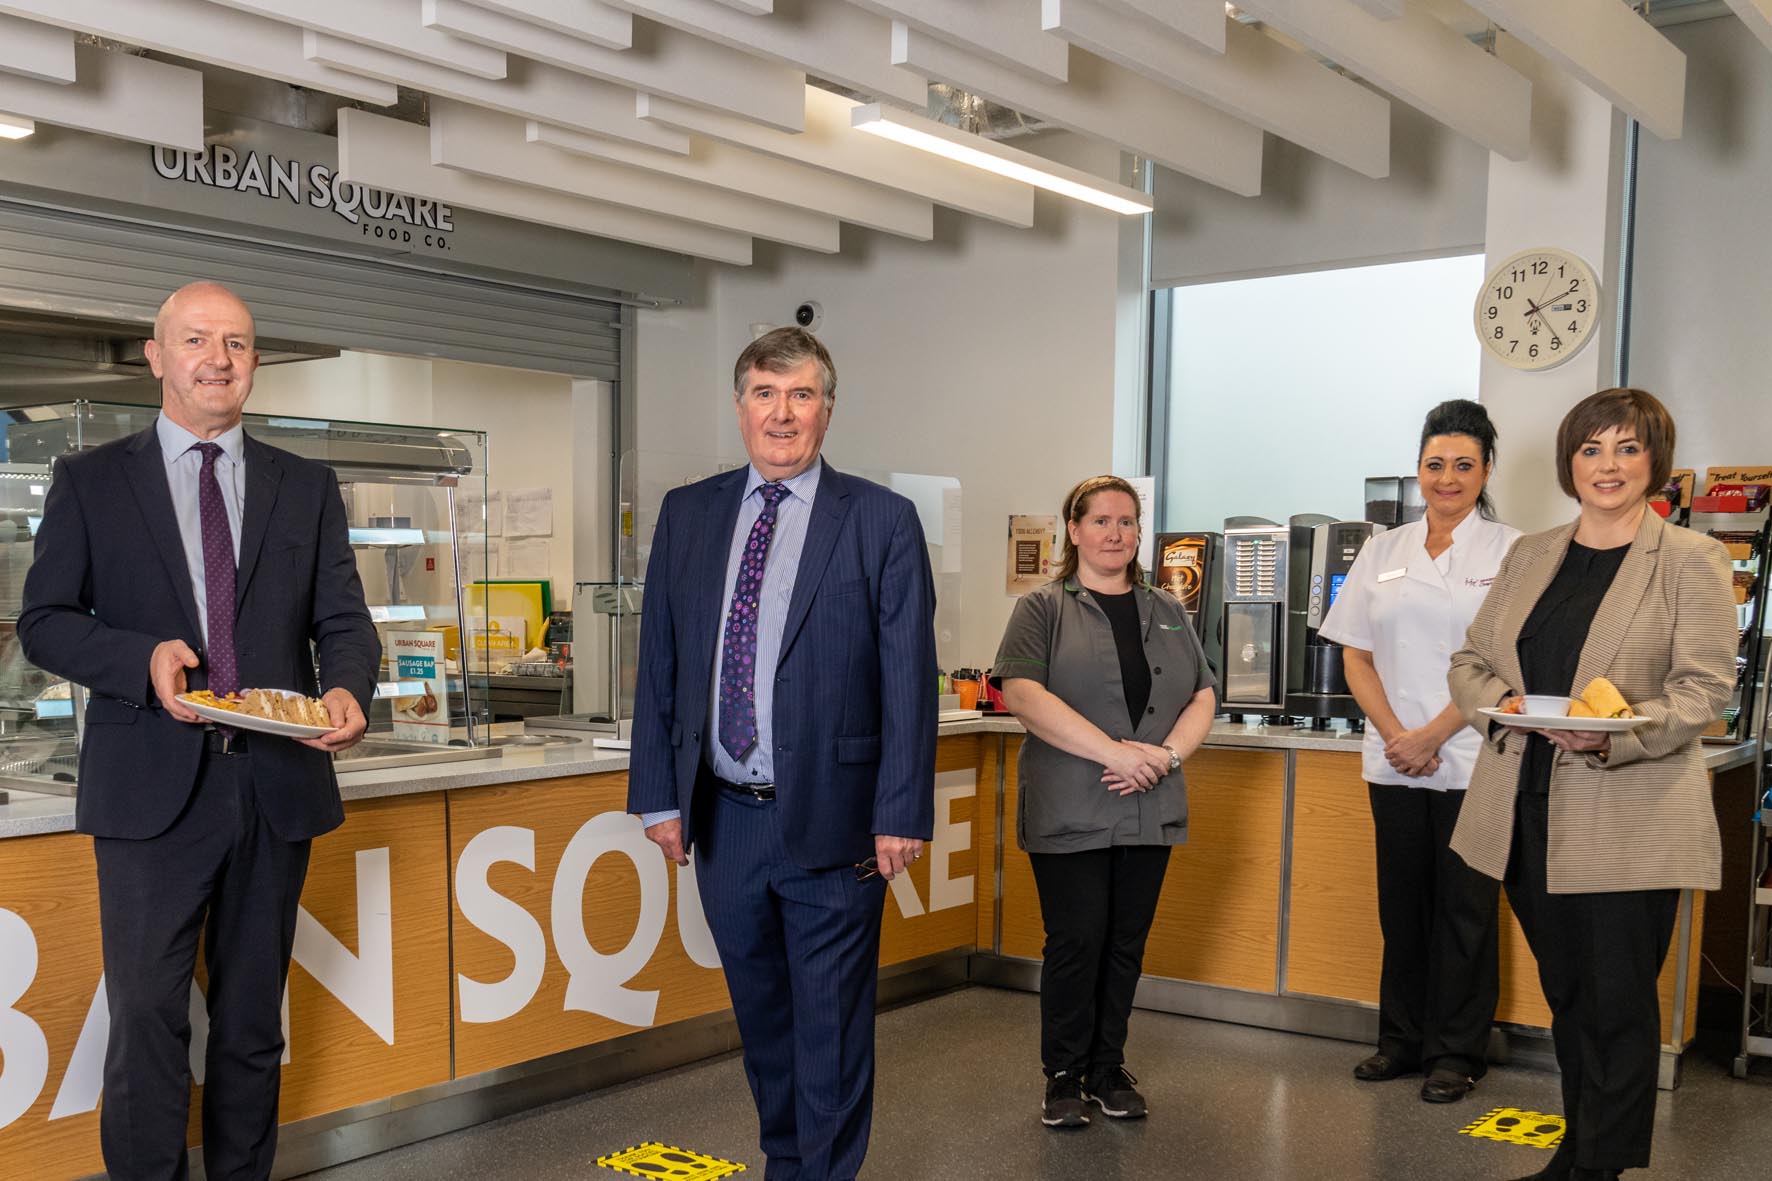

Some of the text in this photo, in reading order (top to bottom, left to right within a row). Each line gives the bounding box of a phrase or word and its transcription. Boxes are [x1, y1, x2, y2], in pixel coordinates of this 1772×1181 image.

[151, 144, 454, 232] URBAN SQUARE
[362, 223, 451, 251] FOOD CO.
[1531, 261, 1549, 275] 12
[1558, 265, 1565, 278] 1
[1512, 269, 1526, 283] 11
[1496, 286, 1513, 300] 10
[1569, 279, 1580, 293] 2
[1488, 306, 1498, 320] 9
[1576, 299, 1587, 313] 3
[1494, 326, 1504, 340] 8
[1568, 320, 1578, 333] 4
[1510, 340, 1519, 353] 7
[1550, 336, 1560, 351] 5
[1529, 344, 1539, 358] 6
[1166, 552, 1196, 568] Galaxy
[414, 640, 436, 649] SQUARE
[398, 659, 423, 667] SAUSAGE
[410, 667, 424, 675] £1.25
